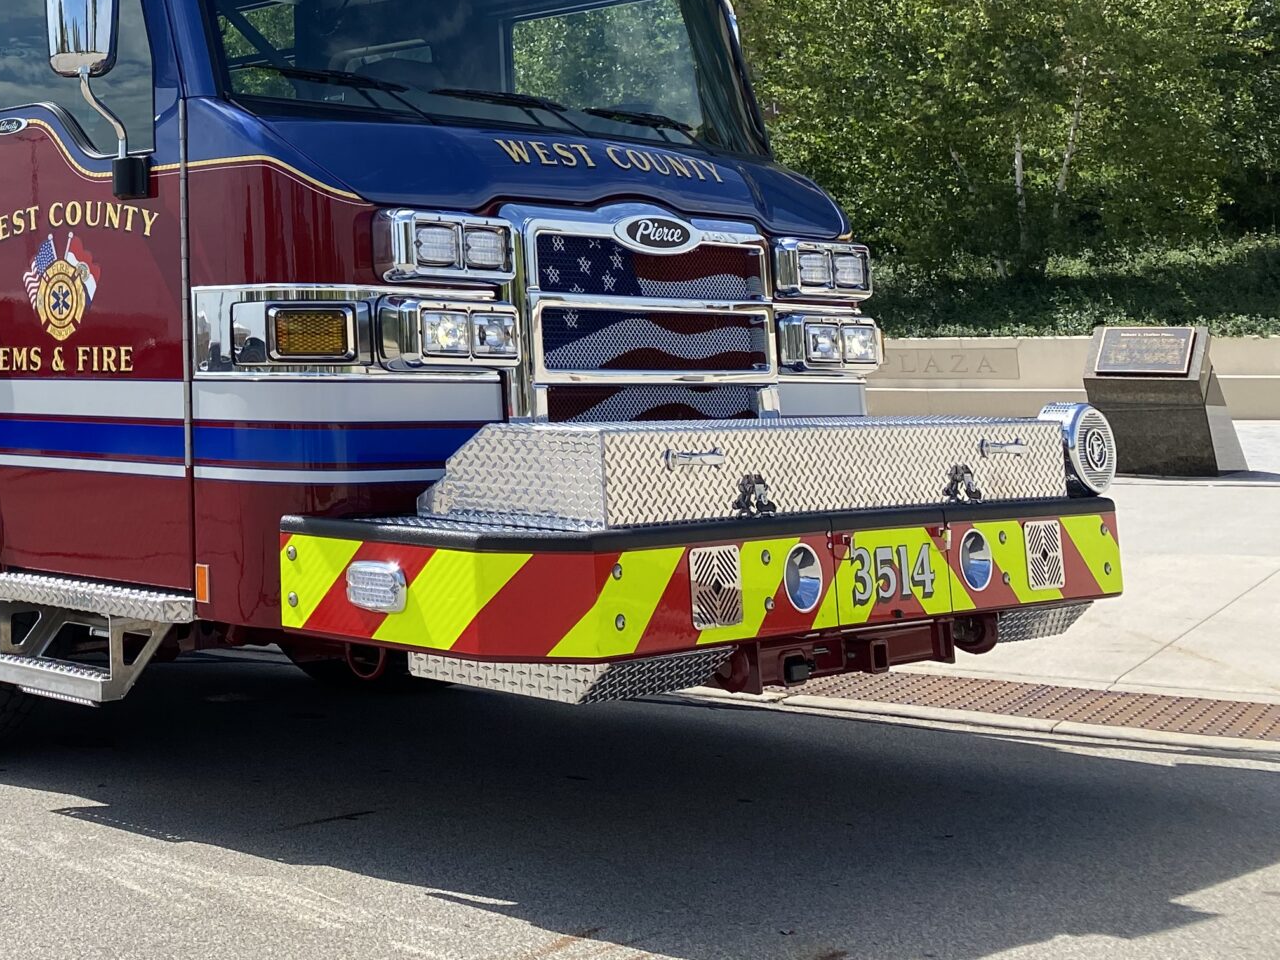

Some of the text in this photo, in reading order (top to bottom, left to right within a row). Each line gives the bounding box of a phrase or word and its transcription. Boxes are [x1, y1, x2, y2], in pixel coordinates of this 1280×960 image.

[494, 139, 724, 183] WEST COUNTY
[48, 201, 160, 237] COUNTY
[635, 219, 684, 243] Pierce
[51, 263, 70, 275] FIRE
[51, 346, 65, 372] &
[77, 346, 134, 372] FIRE
[851, 543, 936, 606] 3514
